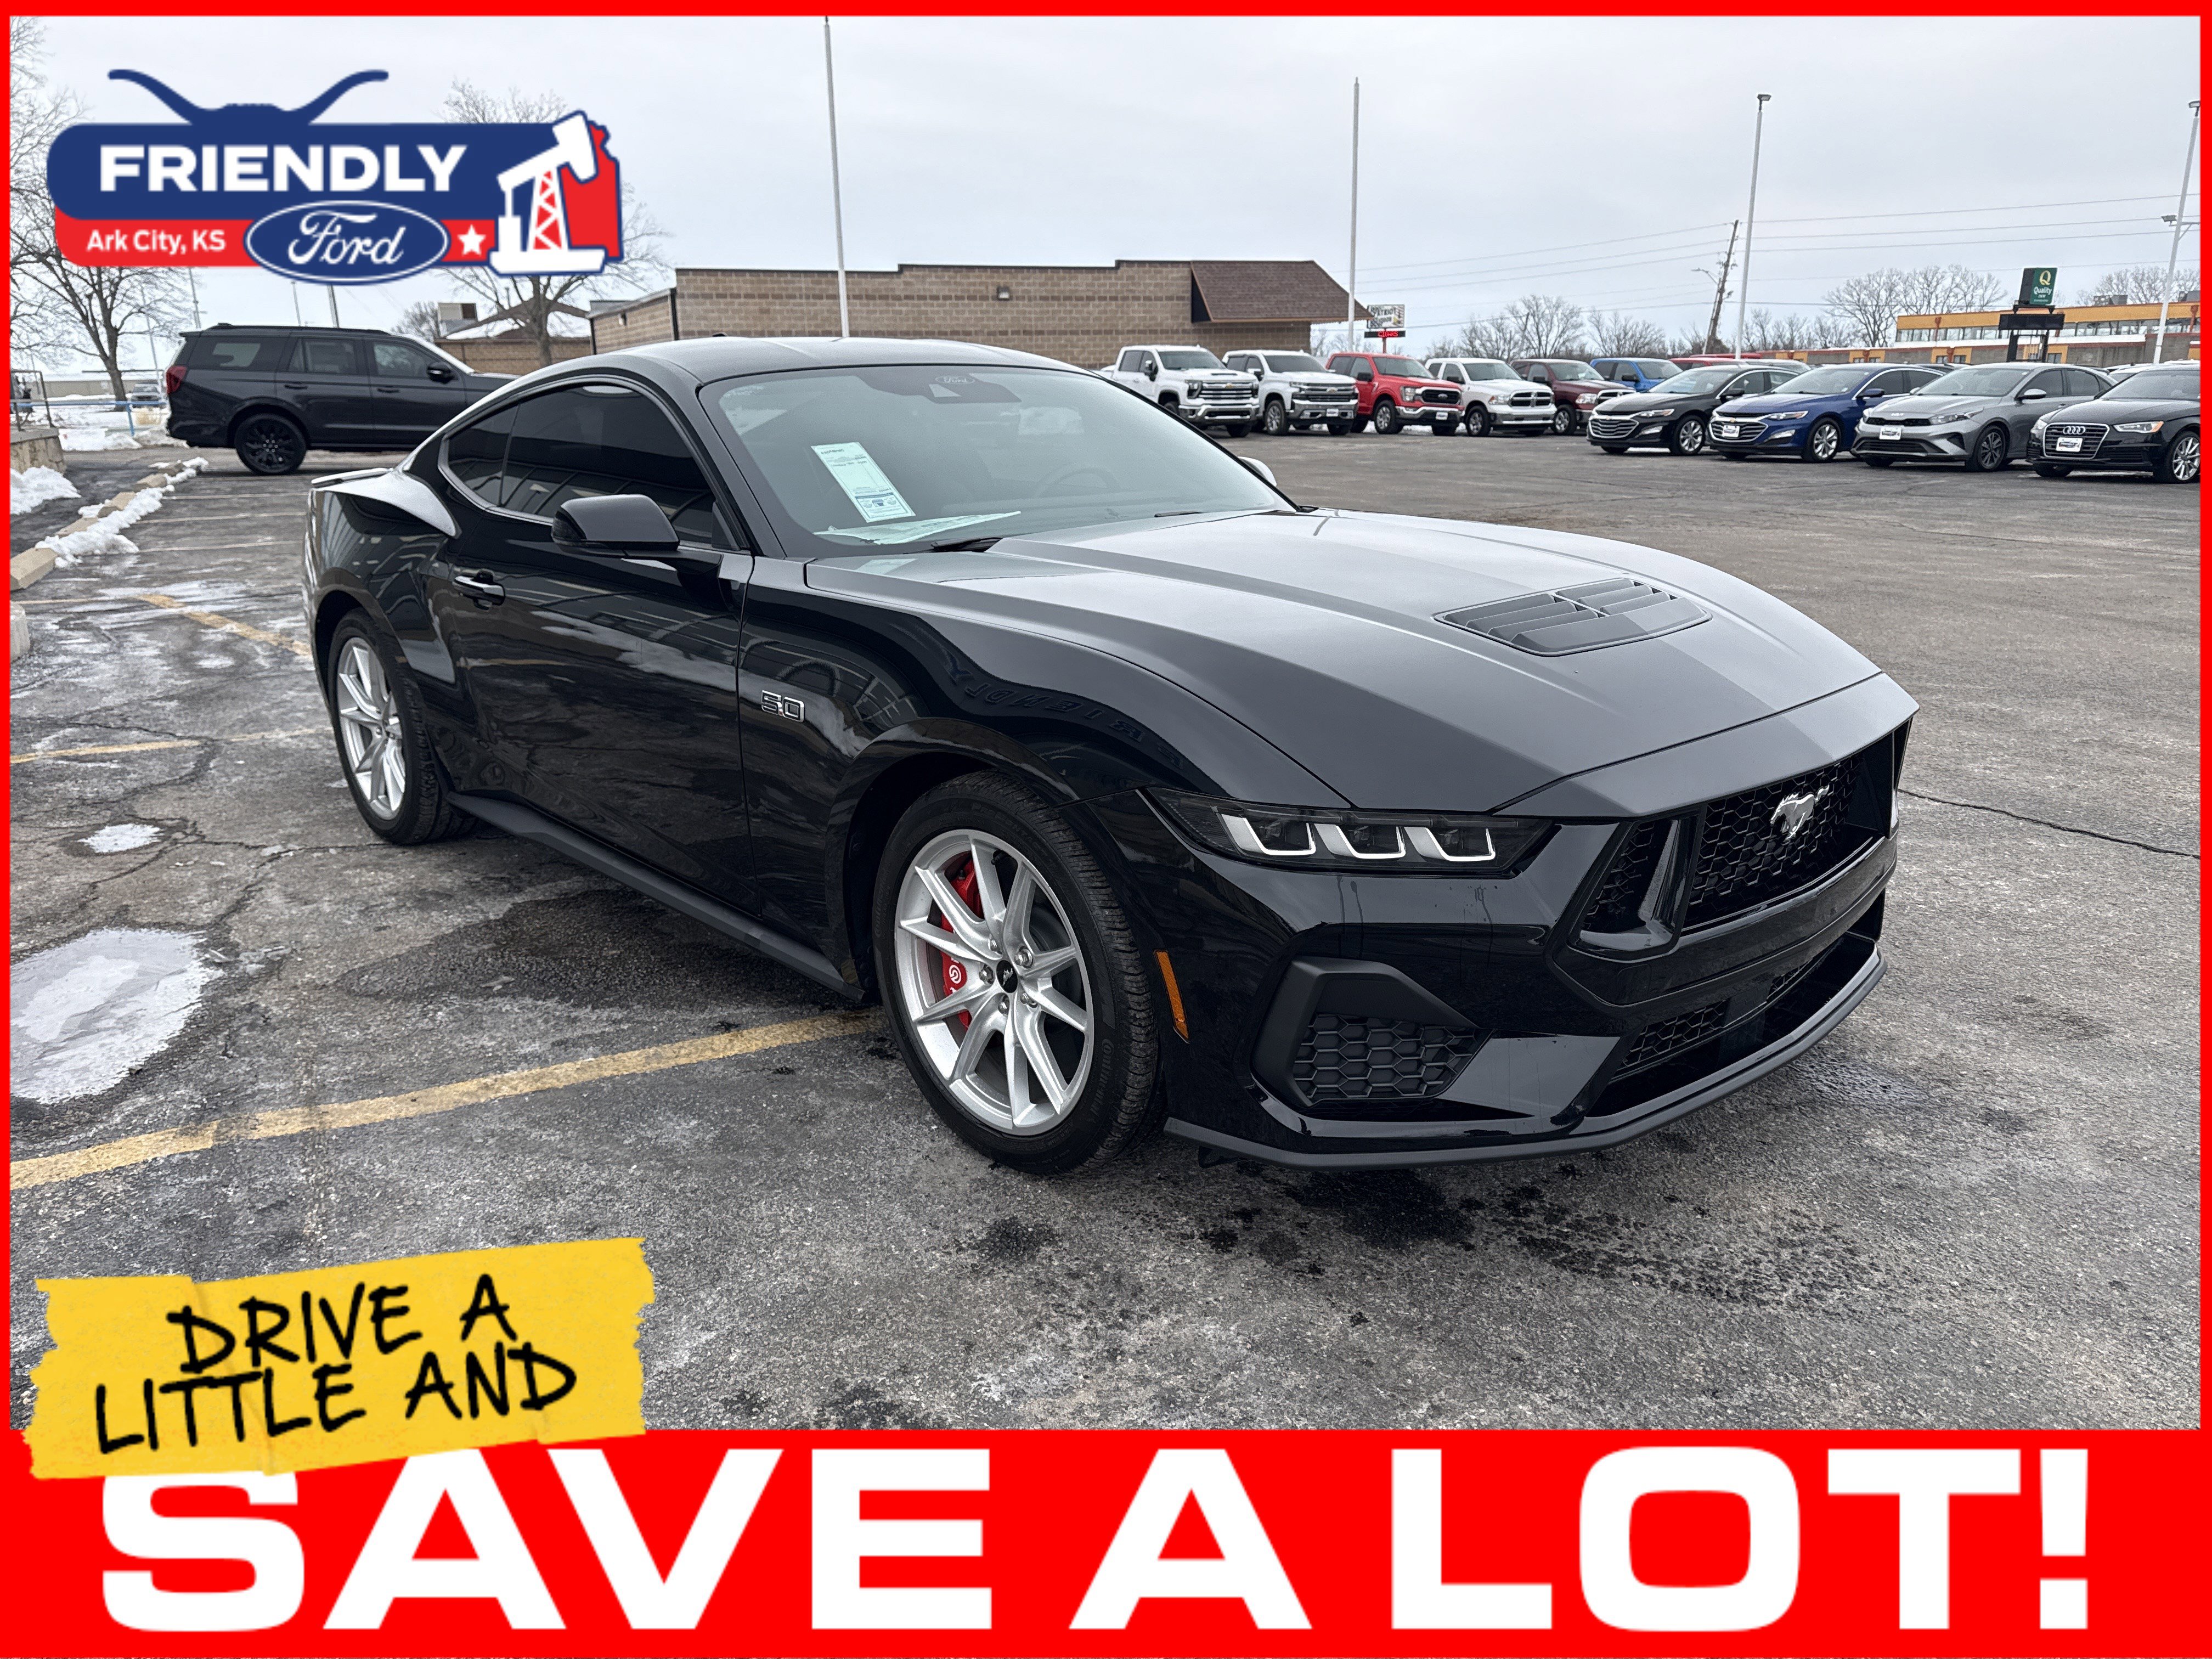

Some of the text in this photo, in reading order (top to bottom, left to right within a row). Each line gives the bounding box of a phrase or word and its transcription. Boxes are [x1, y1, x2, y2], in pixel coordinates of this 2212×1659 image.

[2034, 286, 2052, 295] Quality
[761, 690, 805, 723] 5.0
[1090, 1037, 1115, 1118] Continental
